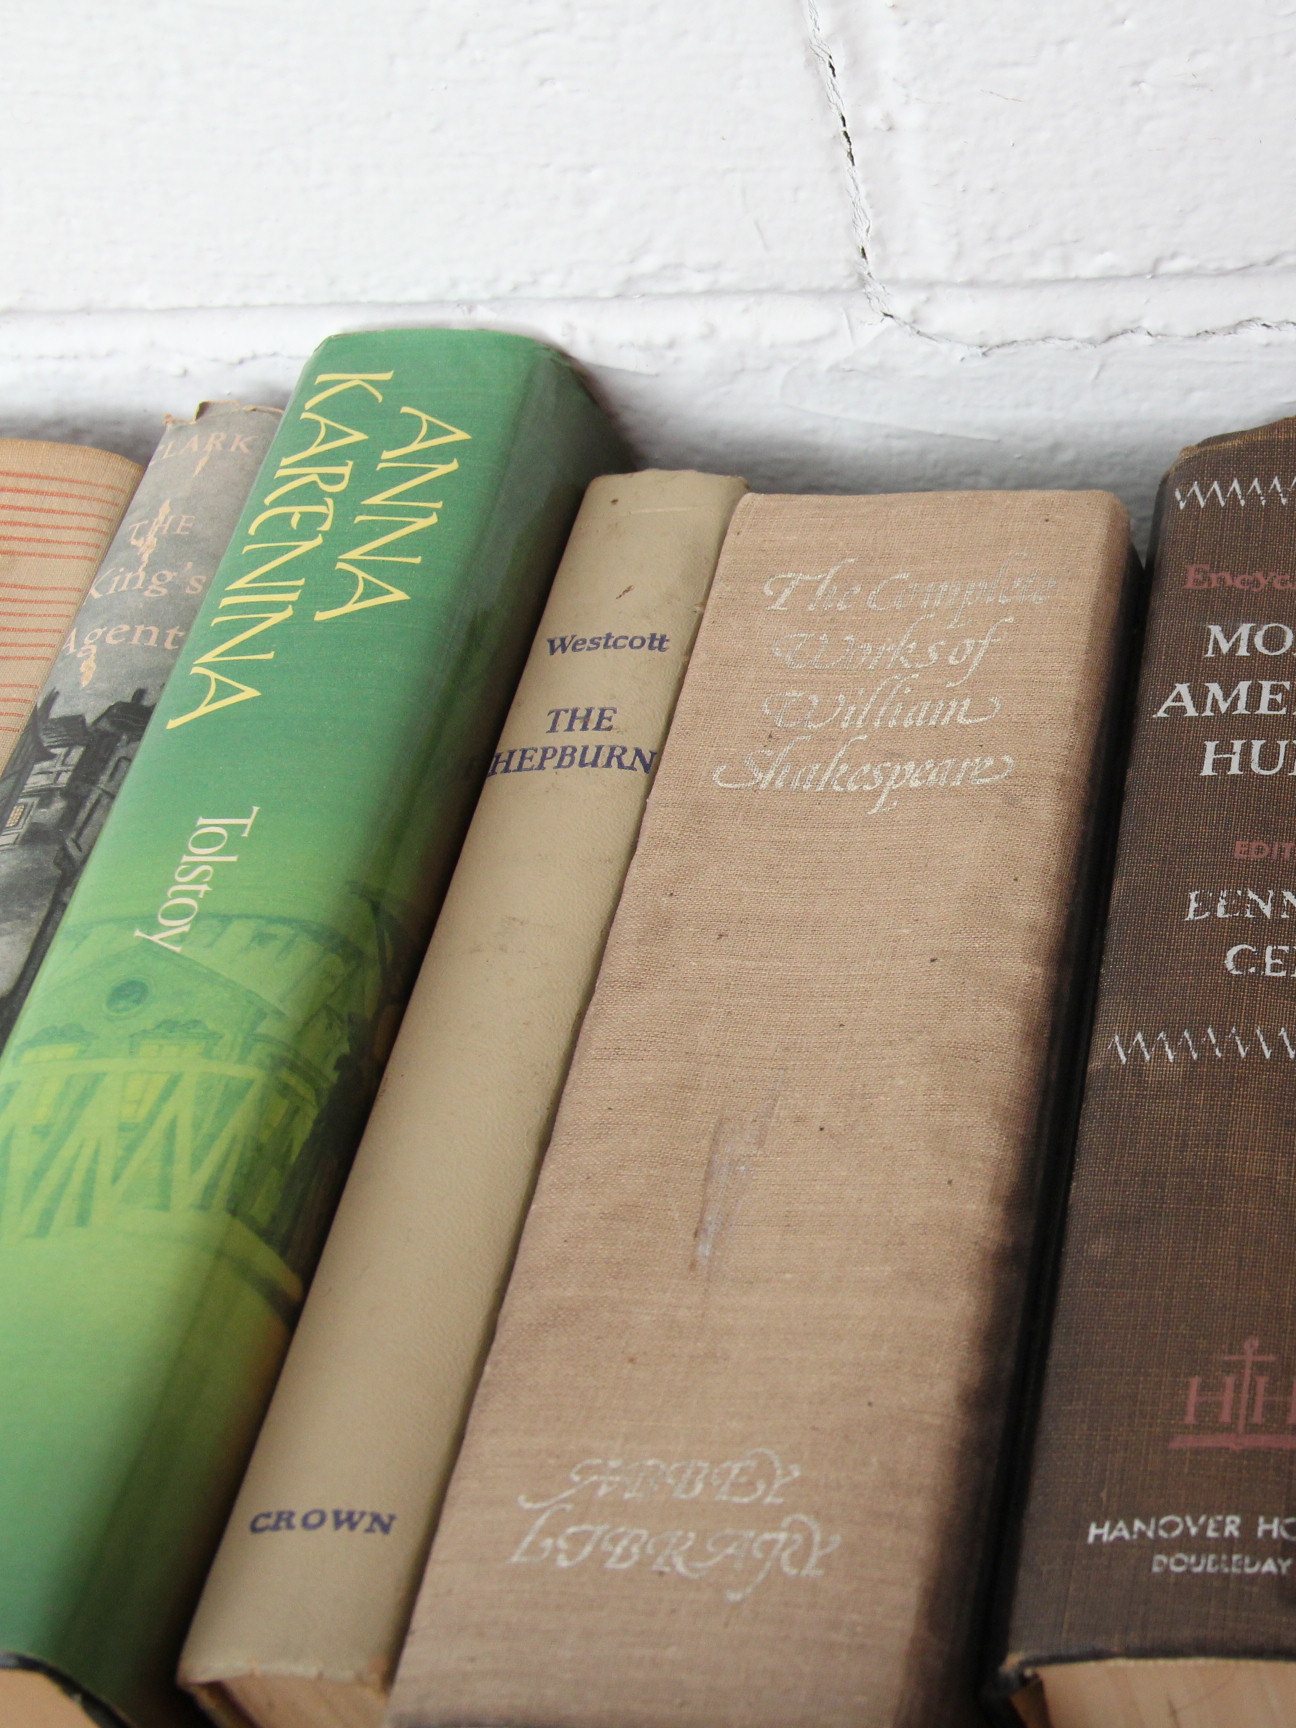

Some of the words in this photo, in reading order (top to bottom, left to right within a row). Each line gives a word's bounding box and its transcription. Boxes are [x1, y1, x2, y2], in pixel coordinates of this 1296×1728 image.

[314, 406, 472, 622] ANNA
[165, 371, 394, 729] KARENINA
[763, 556, 862, 611] The
[867, 551, 1057, 630] Complete
[62, 624, 186, 658] Agent
[547, 632, 669, 656] Westcott
[772, 613, 946, 670] Works
[948, 616, 1015, 688] of
[545, 706, 618, 734] THE
[761, 673, 1001, 730] William
[487, 744, 657, 778] HEPBURN
[712, 734, 1014, 815] Shakespeare
[134, 806, 260, 951] Tolstoy
[250, 1508, 397, 1536] CROWN
[1087, 1514, 1241, 1544] HANOVER
[1151, 1552, 1294, 1576] DOUBLEDAY
